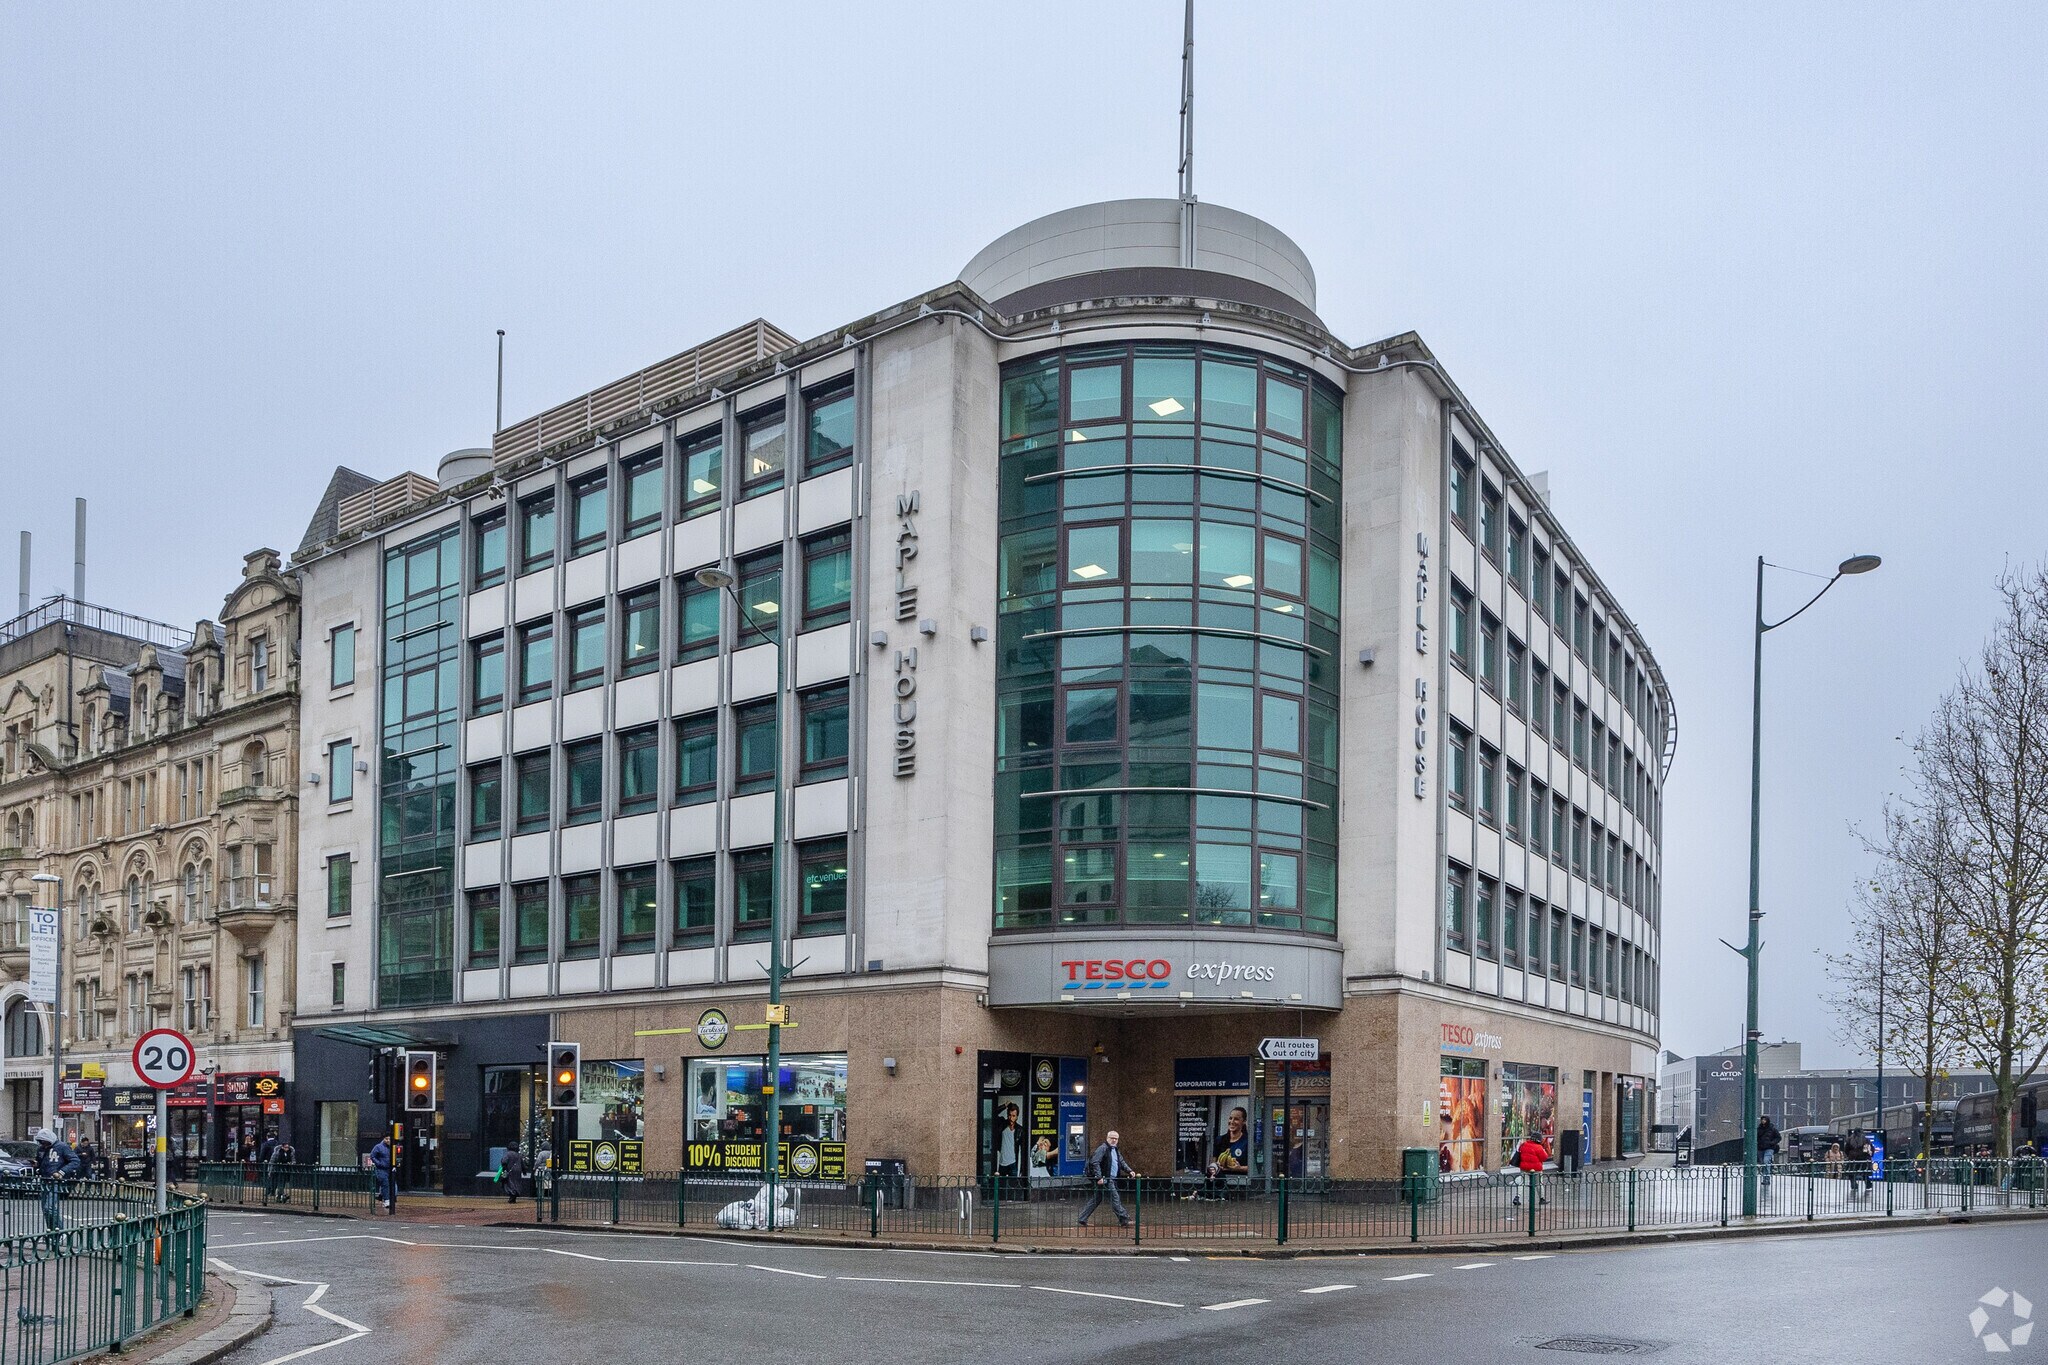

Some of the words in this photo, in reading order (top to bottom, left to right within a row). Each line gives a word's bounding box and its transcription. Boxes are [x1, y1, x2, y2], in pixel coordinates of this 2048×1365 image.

[895, 490, 920, 622] MAPLE
[1416, 532, 1430, 655] MAPLE
[893, 647, 918, 778] HOUSE
[1414, 677, 1428, 800] HOUSE
[34, 912, 54, 923] TO
[31, 923, 56, 934] LET
[1061, 959, 1171, 981] TESCO
[1187, 960, 1275, 986] express
[699, 1025, 727, 1034] Turkish
[1441, 1023, 1474, 1046] TESCO
[1474, 1031, 1502, 1053] express
[1288, 1041, 1315, 1049] routes
[1300, 1050, 1316, 1058] city
[144, 1046, 187, 1071] 20
[1277, 1076, 1331, 1089] epress
[688, 1144, 721, 1167] 10%
[725, 1144, 761, 1156] STUDENT
[725, 1156, 761, 1168] DISCOUNT
